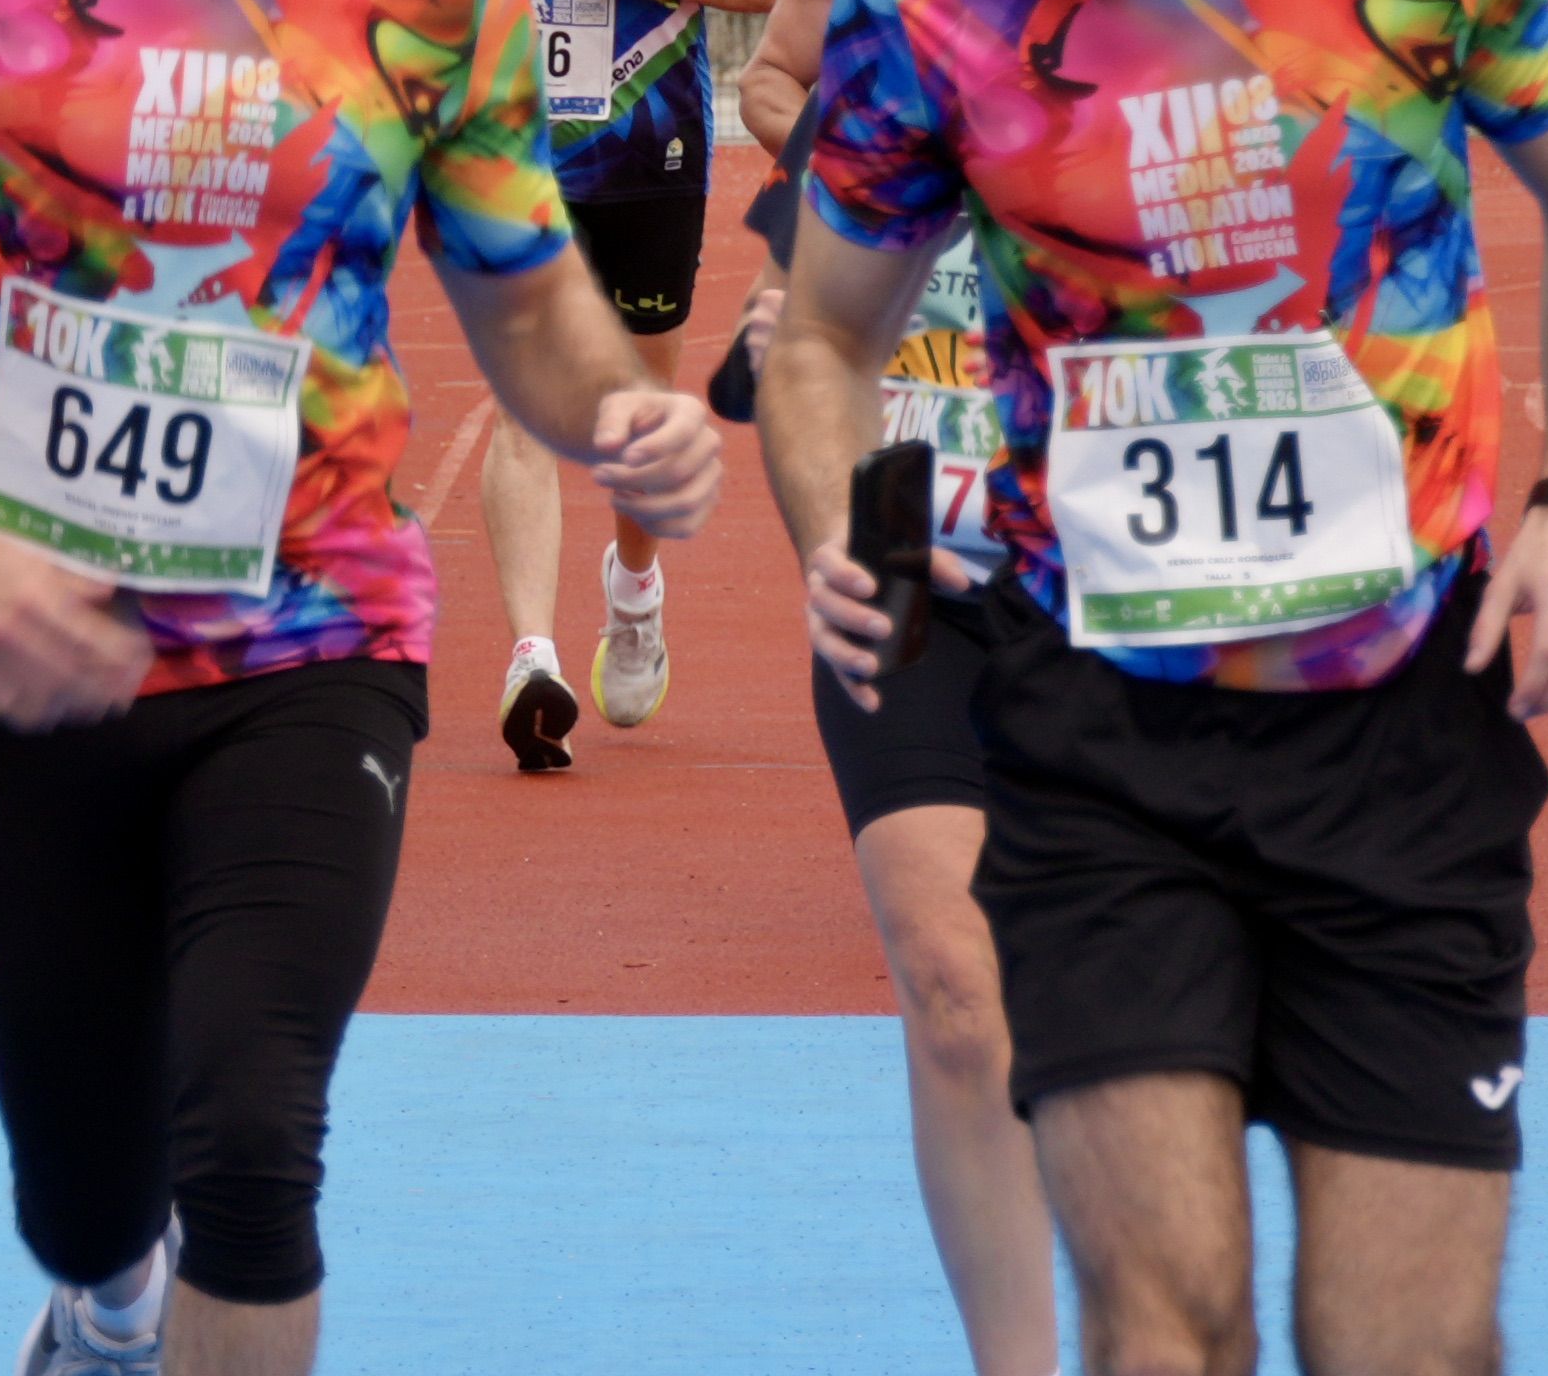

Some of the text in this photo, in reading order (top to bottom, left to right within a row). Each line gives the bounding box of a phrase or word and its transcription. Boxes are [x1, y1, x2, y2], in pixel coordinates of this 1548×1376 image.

[231, 55, 280, 102] 08
[548, 30, 571, 78] 6
[133, 47, 227, 119] XII
[1220, 74, 1280, 124] 08
[129, 115, 224, 155] MEDIA
[1118, 82, 1224, 169] XII
[126, 150, 270, 197] MARATÓN
[1130, 155, 1236, 206] MEDIA
[142, 189, 196, 225] 10K
[1138, 178, 1294, 242] MARATÓN
[1167, 232, 1230, 275] 10K
[1234, 236, 1298, 264] LUCENA
[27, 301, 113, 380] 10K
[1082, 357, 1177, 428] 10K
[1256, 389, 1297, 411] 2026
[883, 389, 946, 450] 10K
[45, 384, 213, 507] 649
[1123, 430, 1314, 547] 314
